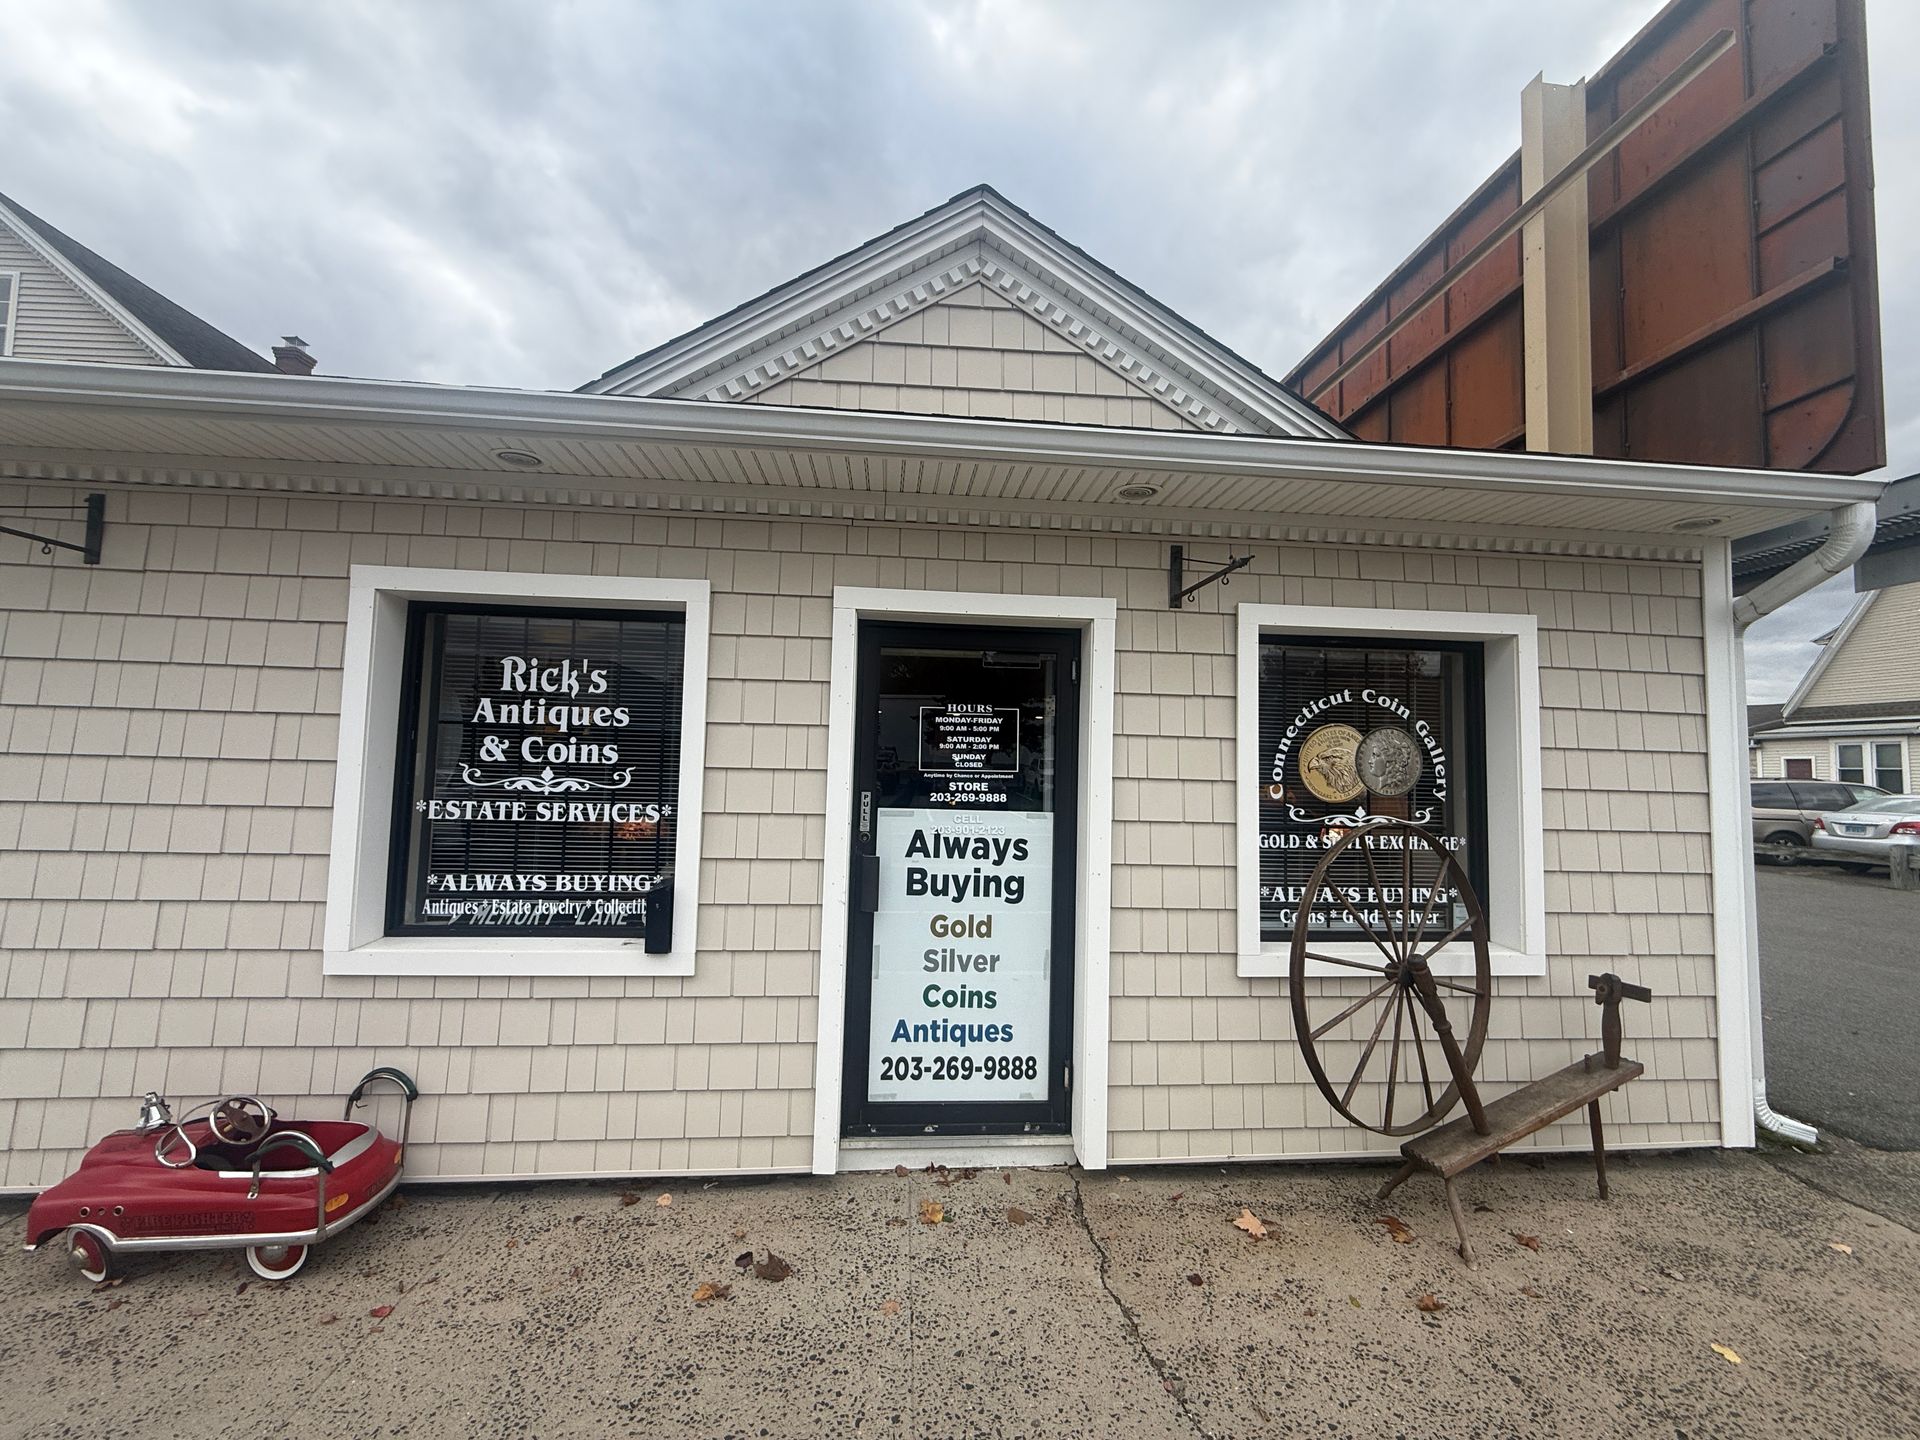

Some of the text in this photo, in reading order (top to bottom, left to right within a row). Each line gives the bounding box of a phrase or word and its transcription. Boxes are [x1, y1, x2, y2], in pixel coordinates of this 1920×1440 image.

[500, 655, 607, 699] Rick's
[471, 697, 630, 732] Antiques
[947, 703, 993, 713] HOURS
[479, 735, 619, 764] & Coins
[1269, 689, 1353, 800] Connecticut
[1361, 689, 1411, 720] Coin
[1415, 719, 1447, 802] Gallery
[929, 793, 1007, 803] 203-269-9888
[949, 782, 989, 791] STORE
[427, 799, 661, 823] ESTATE SERVICES
[953, 814, 983, 824] CELL
[930, 825, 1006, 835] 203-901-2123
[1259, 834, 1300, 849] GOLD
[1305, 834, 1318, 849] &
[1379, 835, 1460, 851] EXCHAGE
[905, 829, 1029, 866] Always
[439, 874, 651, 892] ALWAYS BUYING
[905, 867, 1025, 904] Buying
[422, 898, 647, 919] Antiques Estate Jewelry Collectib
[1280, 908, 1325, 924] Cons
[1395, 909, 1440, 924] Slver
[930, 914, 992, 939] Gold
[923, 948, 1000, 973] Silver
[922, 984, 997, 1009] Coins
[890, 1018, 1014, 1047] Antiques
[880, 1055, 1038, 1081] 203-269-9888
